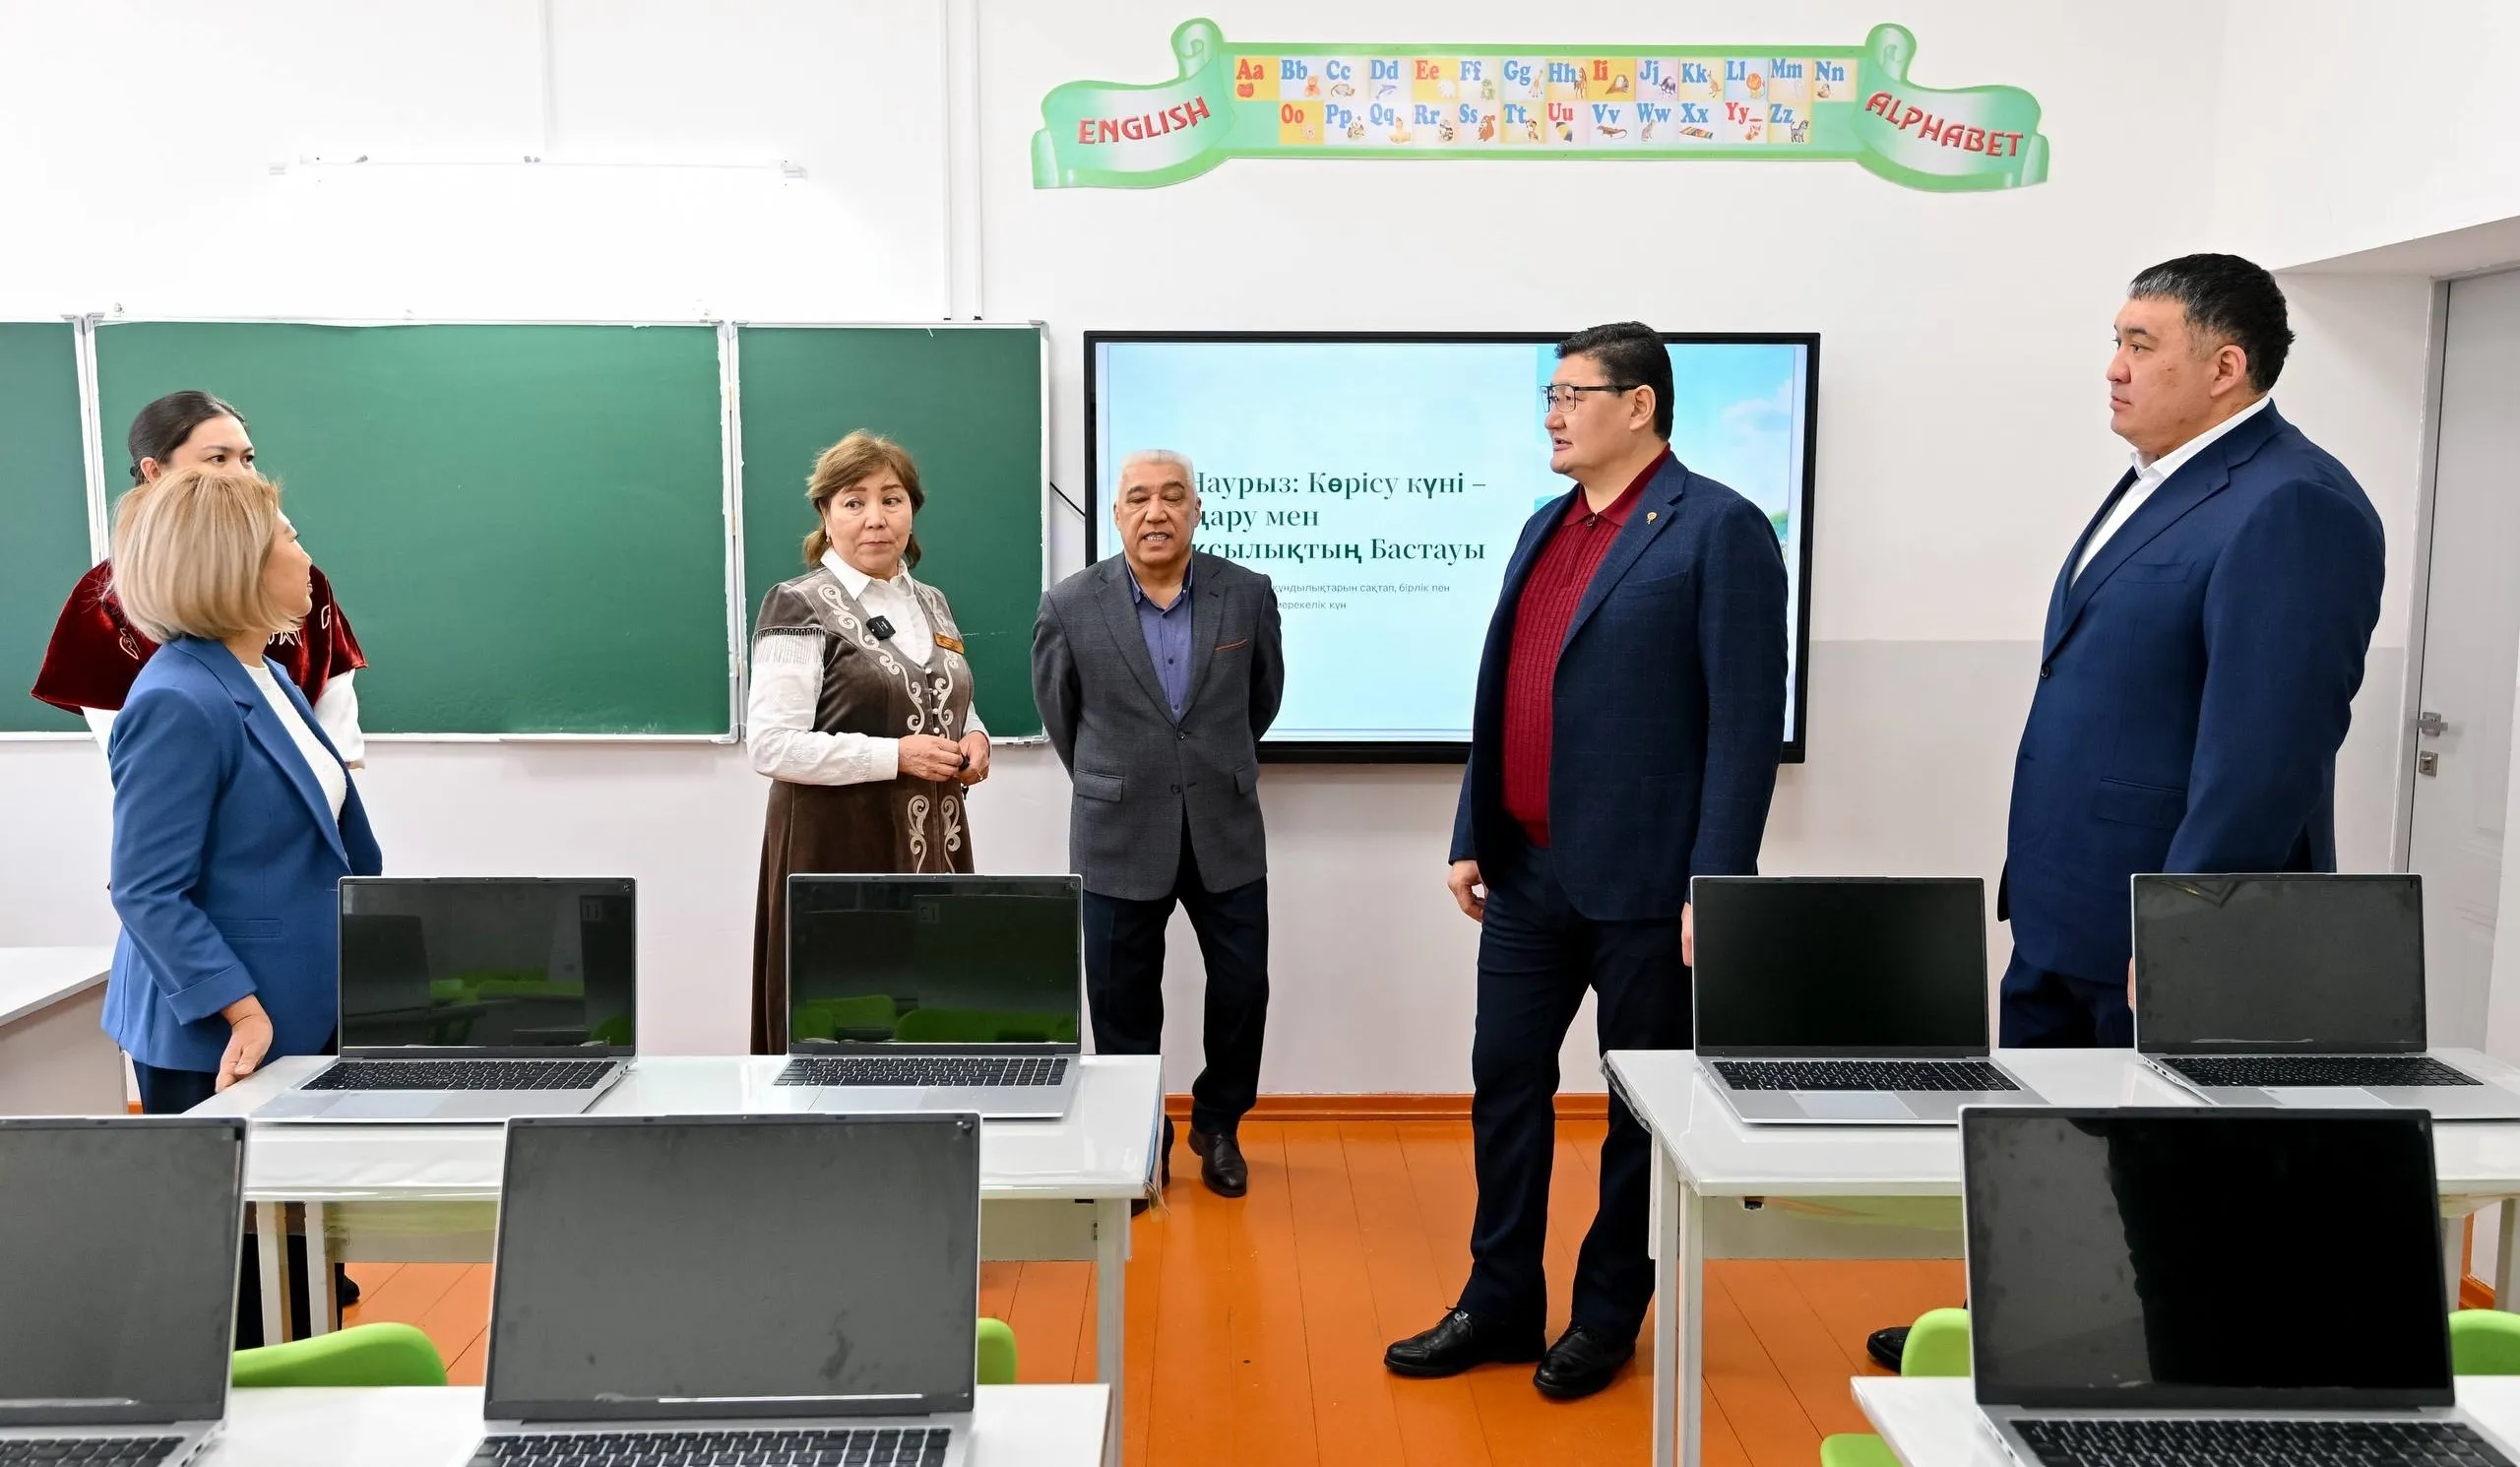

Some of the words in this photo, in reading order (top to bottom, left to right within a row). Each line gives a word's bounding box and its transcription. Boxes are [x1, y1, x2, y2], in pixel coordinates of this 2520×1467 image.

[1236, 59, 1265, 80] Aa
[1281, 59, 1308, 80] Bb
[1326, 59, 1352, 80] Cc
[1370, 59, 1399, 80] Dd
[1416, 60, 1439, 80] Ee
[1460, 60, 1481, 81] Ff
[1503, 60, 1531, 86] Gg
[1547, 62, 1576, 84] Hh
[1594, 60, 1608, 81] Ii
[1639, 60, 1660, 86] Jj
[1681, 62, 1708, 84] Kk
[1727, 60, 1746, 81] Ll
[1771, 57, 1802, 79] Mm
[1815, 61, 1845, 81] Nn
[1078, 96, 1211, 144] ENGLISH
[1281, 103, 1304, 124] Oo
[1325, 103, 1353, 129] Pp
[1369, 102, 1395, 126] Qq
[1414, 104, 1440, 124] Rr
[1459, 103, 1479, 124] Ss
[1503, 103, 1527, 124] Tt
[1547, 102, 1574, 121] Uu
[1592, 103, 1620, 124] Vv
[1636, 102, 1671, 122] Ww
[1680, 102, 1709, 123] Xx
[1769, 103, 1793, 124] Zz
[1864, 91, 2024, 157] ALPHABET
[1307, 472, 1399, 500] Көрісу
[1407, 472, 1464, 499] күні
[1265, 509, 1320, 527] мен
[1369, 538, 1486, 566] Бастауы
